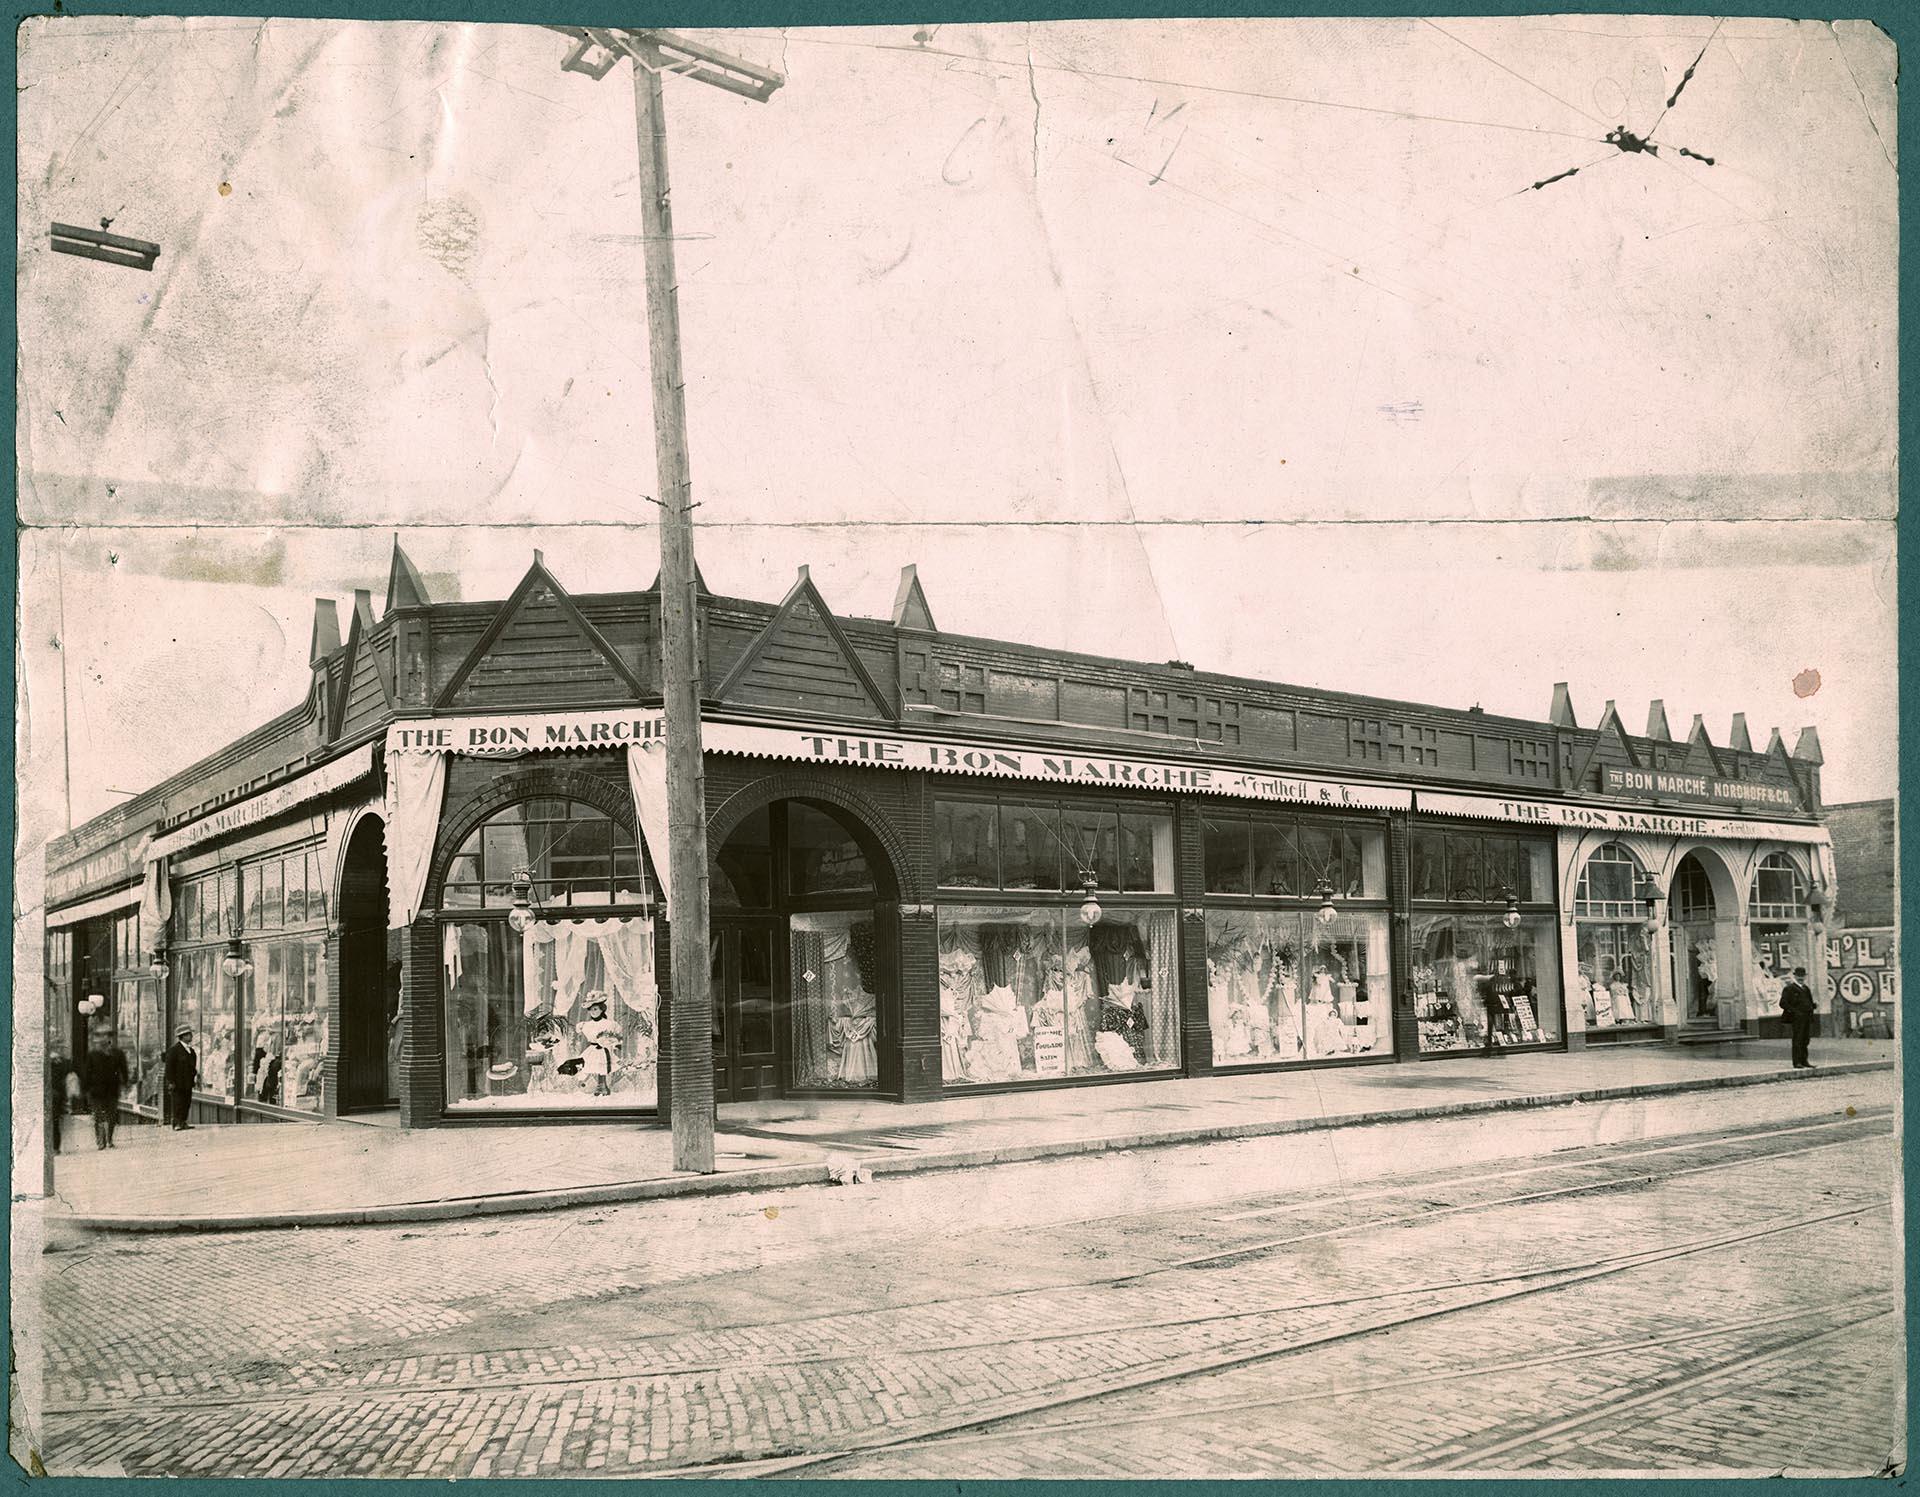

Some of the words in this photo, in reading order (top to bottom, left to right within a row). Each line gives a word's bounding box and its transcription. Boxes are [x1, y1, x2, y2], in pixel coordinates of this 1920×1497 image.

[397, 728, 453, 748] THE
[468, 726, 530, 746] BON
[801, 736, 904, 763] THE
[929, 747, 1022, 772] BON
[1319, 787, 1331, 801] &
[1609, 773, 1624, 785] THE
[1625, 772, 1653, 791] BON
[1499, 802, 1550, 820] THE
[1562, 809, 1609, 826] BON
